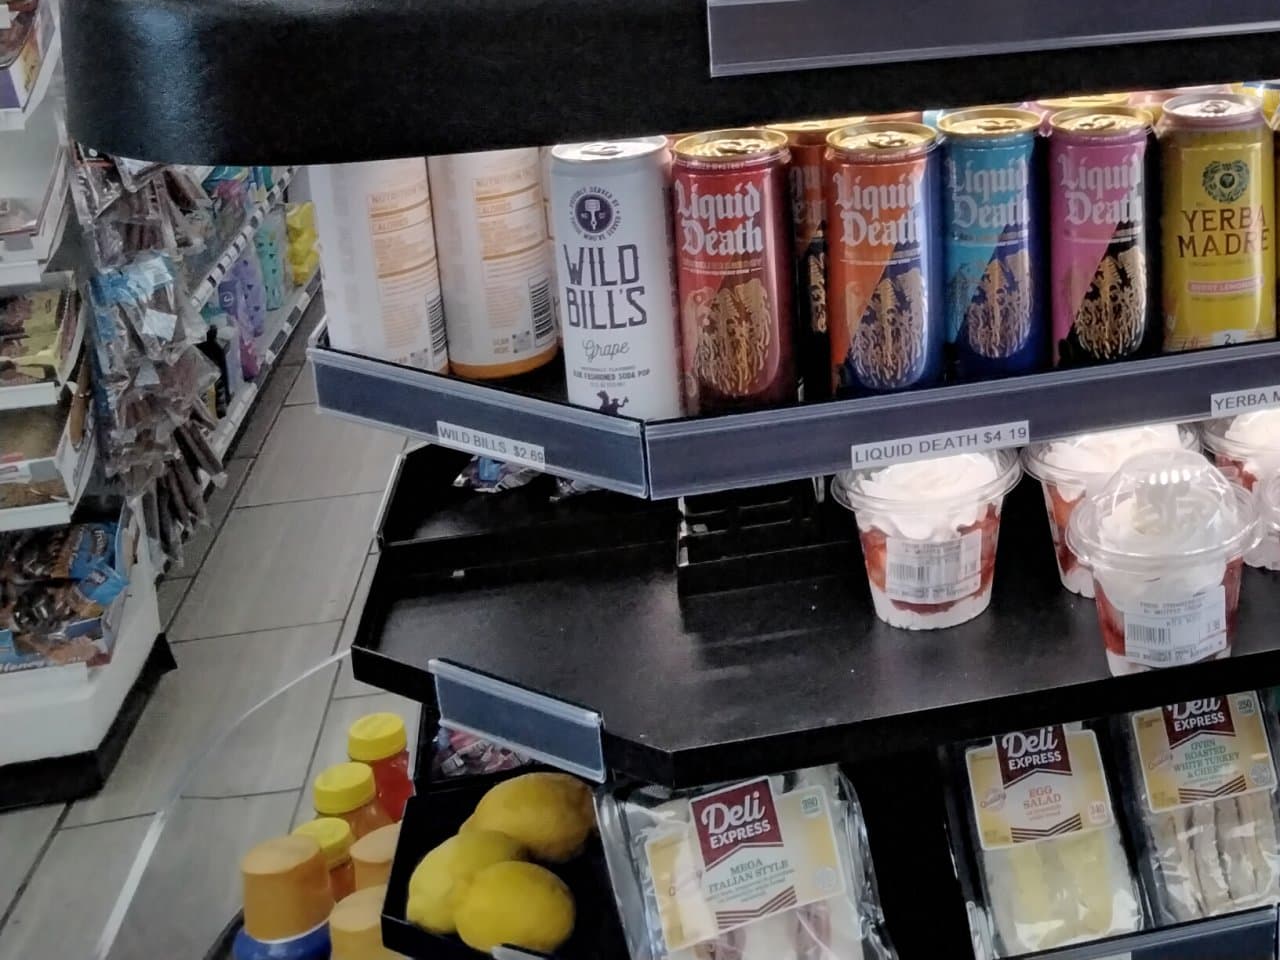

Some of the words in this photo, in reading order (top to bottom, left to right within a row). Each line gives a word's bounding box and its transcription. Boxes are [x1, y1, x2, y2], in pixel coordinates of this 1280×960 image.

[945, 154, 1029, 200] Liquid
[1057, 152, 1143, 200] Liquid
[675, 179, 761, 229] Liquid
[833, 170, 924, 218] Liquid
[952, 190, 1031, 229] Death
[1064, 191, 1143, 227] Death
[681, 212, 764, 256] Death
[840, 209, 922, 247] Death
[1181, 203, 1267, 234] YERBA
[1176, 228, 1270, 259] MADRE
[563, 243, 640, 287] WILD
[565, 286, 649, 330] BILL'S
[582, 339, 631, 363] Grape
[1214, 392, 1270, 411] YERBA
[439, 426, 470, 444] WILD
[473, 435, 506, 454] BILLS
[855, 442, 913, 463] LIQUID
[919, 433, 978, 456] DEATH
[983, 426, 1028, 445] $4.19
[1174, 711, 1225, 732] EXPRESS
[1001, 726, 1058, 759] Deli
[1185, 745, 1226, 761] ROASTED
[1205, 751, 1240, 766] TURKEY
[1008, 750, 1062, 771] EXPRESS
[1023, 793, 1062, 810] SALAD
[1028, 785, 1053, 798] EGG
[702, 791, 766, 836] Deli
[709, 819, 771, 849] EXPRESS
[708, 872, 753, 895] ITALIAN
[754, 859, 790, 879] STYLE
[729, 858, 764, 876] MEGA
